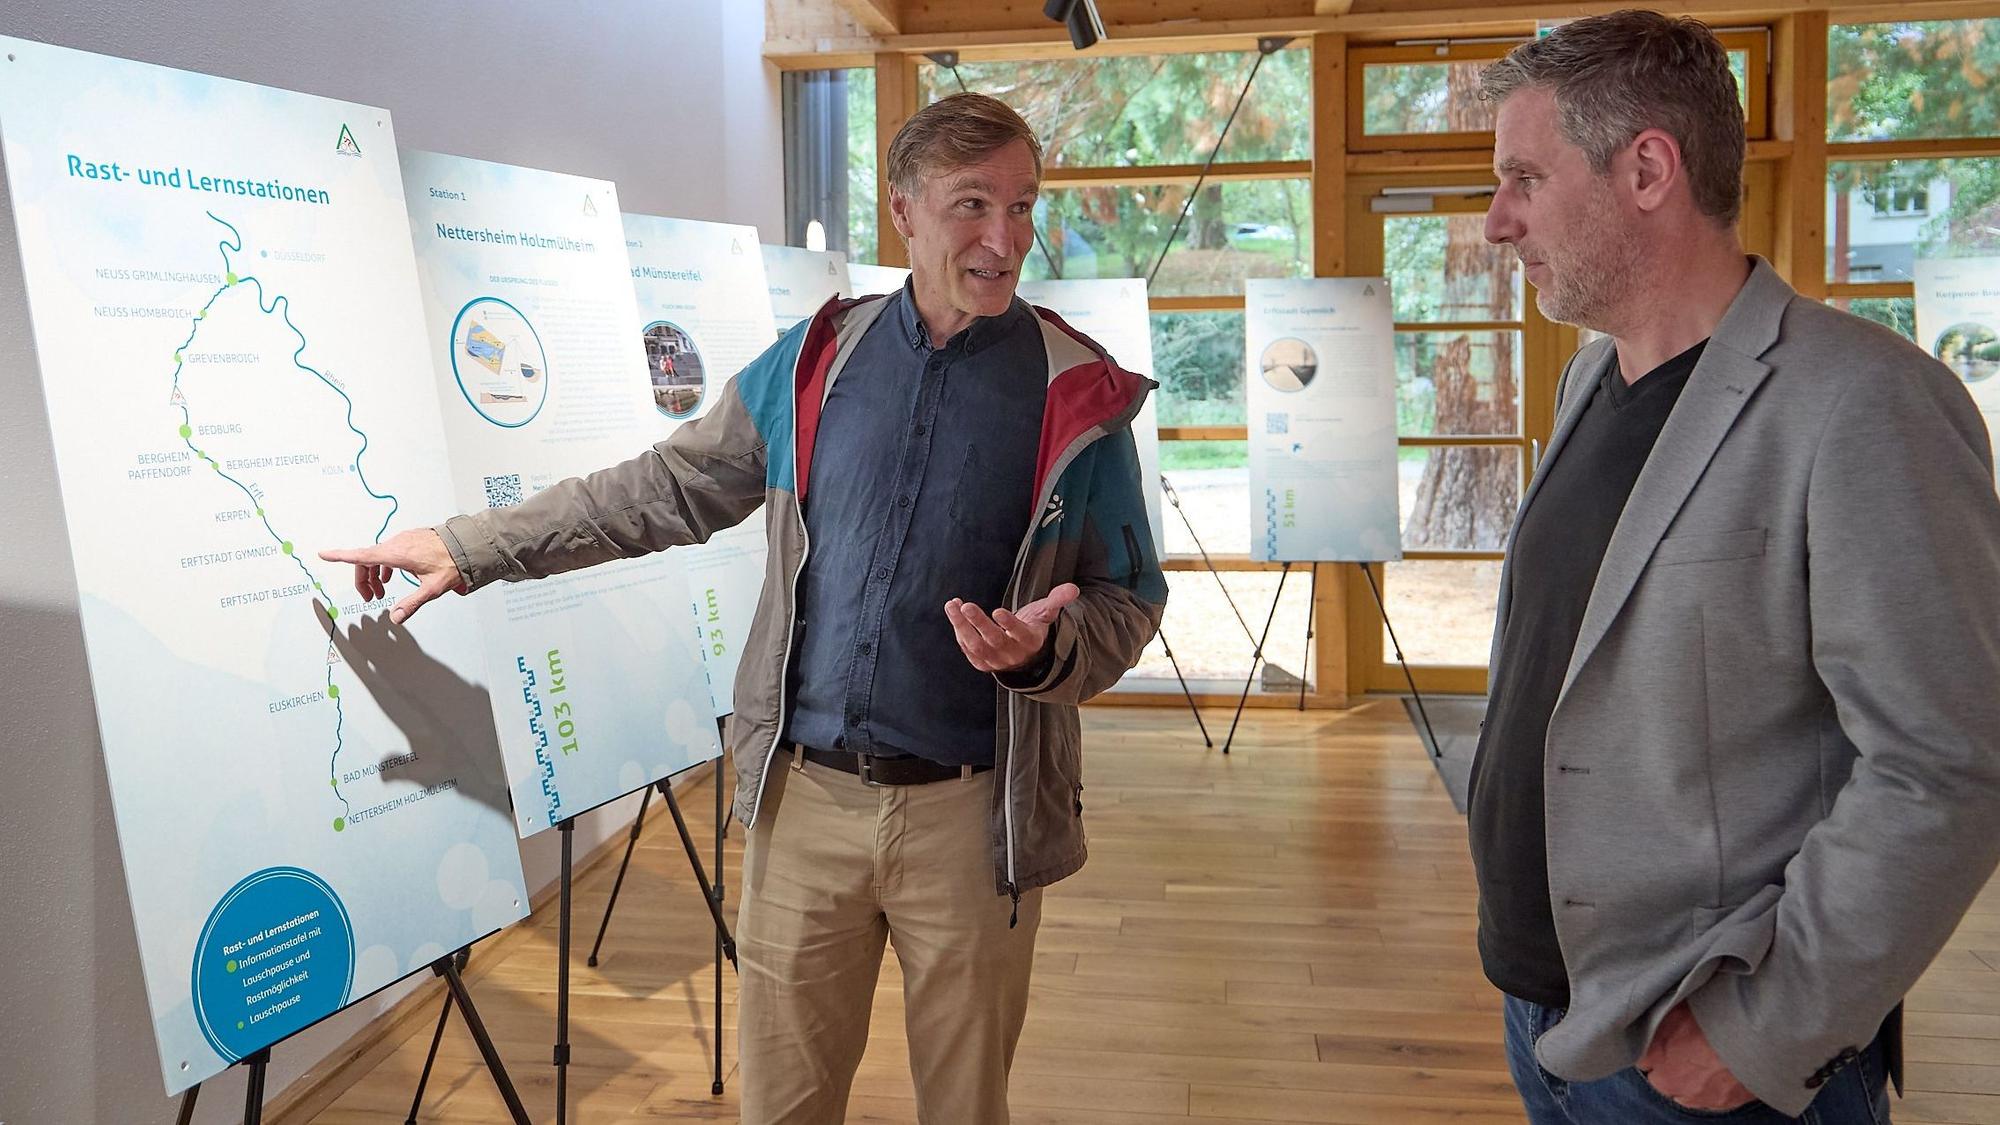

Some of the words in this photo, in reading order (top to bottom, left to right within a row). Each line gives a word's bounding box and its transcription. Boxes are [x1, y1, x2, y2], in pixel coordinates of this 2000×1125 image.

[66, 154, 130, 181] Rast-
[138, 167, 181, 188] und
[187, 169, 330, 205] Lernstationen
[429, 187, 458, 201] Station
[461, 191, 467, 201] 1
[436, 223, 517, 246] Nettersheim
[520, 232, 595, 253] Holzmülheim
[95, 268, 131, 281] NEUSS
[132, 271, 221, 284] GRIMLINGHAUSEN
[631, 265, 641, 279] ad
[642, 266, 702, 282] Münstereifel
[94, 306, 129, 318] NEUSS
[131, 308, 192, 319] HOMBROICH
[188, 352, 260, 365] GREVENBROICH
[323, 369, 346, 390] Rhein
[198, 423, 242, 436] BEDBURG
[137, 451, 190, 465] BERGHEIM
[226, 456, 273, 470] BERGHEIM
[275, 453, 320, 467] ZIEVERICH
[128, 466, 192, 480] PAFFENDORF
[214, 509, 251, 523] KERPEN
[181, 552, 232, 569] ERFTSTADT
[234, 545, 277, 561] GYMNICH
[220, 591, 270, 608] ERFTSTADT
[272, 584, 310, 600] BLESSEM
[341, 596, 397, 616] WEILERSWIST
[705, 588, 720, 623] km
[710, 628, 726, 657] 93
[548, 649, 567, 695] km
[269, 691, 324, 713] EUSKIRCHEN
[554, 701, 579, 757] 103
[343, 770, 360, 784] BAD
[361, 751, 419, 780] MÜNSTEREIFEL
[348, 797, 403, 825] NETTERSHEIM
[404, 777, 458, 808] HOLZMÜLHEIM
[223, 939, 246, 956] Rast-
[248, 932, 264, 946] und
[265, 910, 319, 939] Lernstationen
[239, 934, 307, 970] Informationstafel
[308, 926, 321, 940] mit
[242, 957, 293, 988] Lauschpause
[294, 950, 311, 965] und
[246, 970, 309, 1006] Rastmöglichkeit
[249, 993, 301, 1025] Lauschpause
